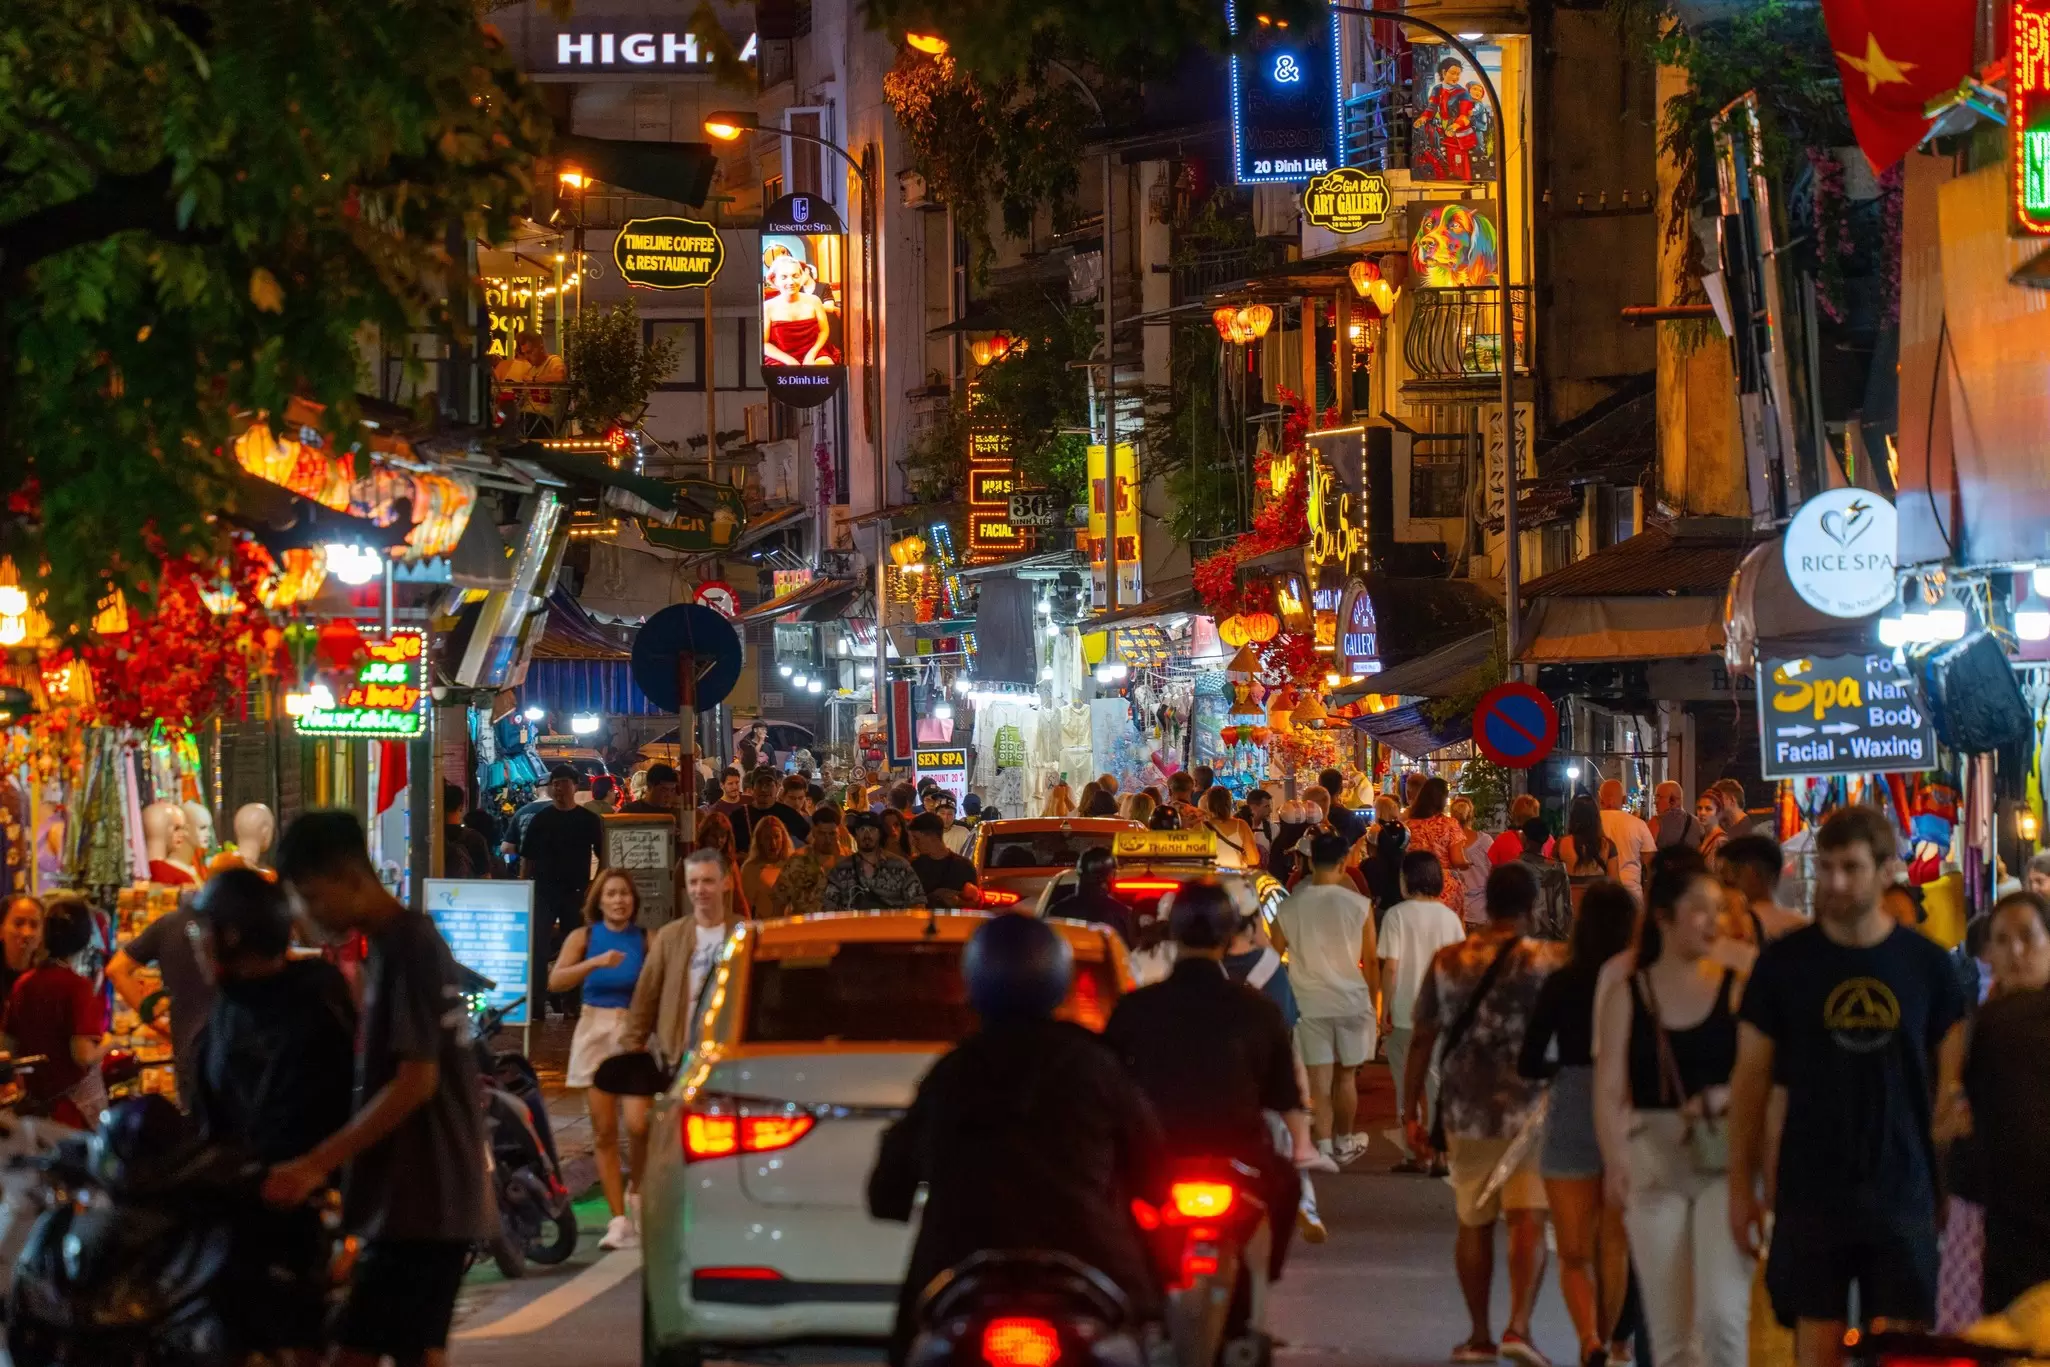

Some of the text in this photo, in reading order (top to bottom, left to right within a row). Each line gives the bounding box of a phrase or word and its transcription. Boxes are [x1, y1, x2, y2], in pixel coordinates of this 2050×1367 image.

[1274, 55, 1299, 82] &
[1254, 160, 1271, 174] 20
[1305, 158, 1328, 174] Liệt
[1314, 193, 1383, 215] ART GALLERY
[769, 222, 832, 233] L'essence Spa
[623, 234, 715, 252] TIMELINE COFFEE
[625, 254, 711, 272] & RESTAURANT
[777, 376, 787, 385] 36
[980, 524, 1014, 538] FACIAL
[1802, 554, 1894, 572] RICE SPA
[1344, 633, 1376, 656] GALLERY
[1773, 659, 1863, 721] Spa
[1869, 704, 1922, 729] Body
[1776, 738, 1834, 763] Facial
[1850, 736, 1923, 760] Waxing
[918, 752, 964, 766] SEN SPA
[1167, 834, 1188, 842] TAXI
[1150, 844, 1181, 852] THANH
